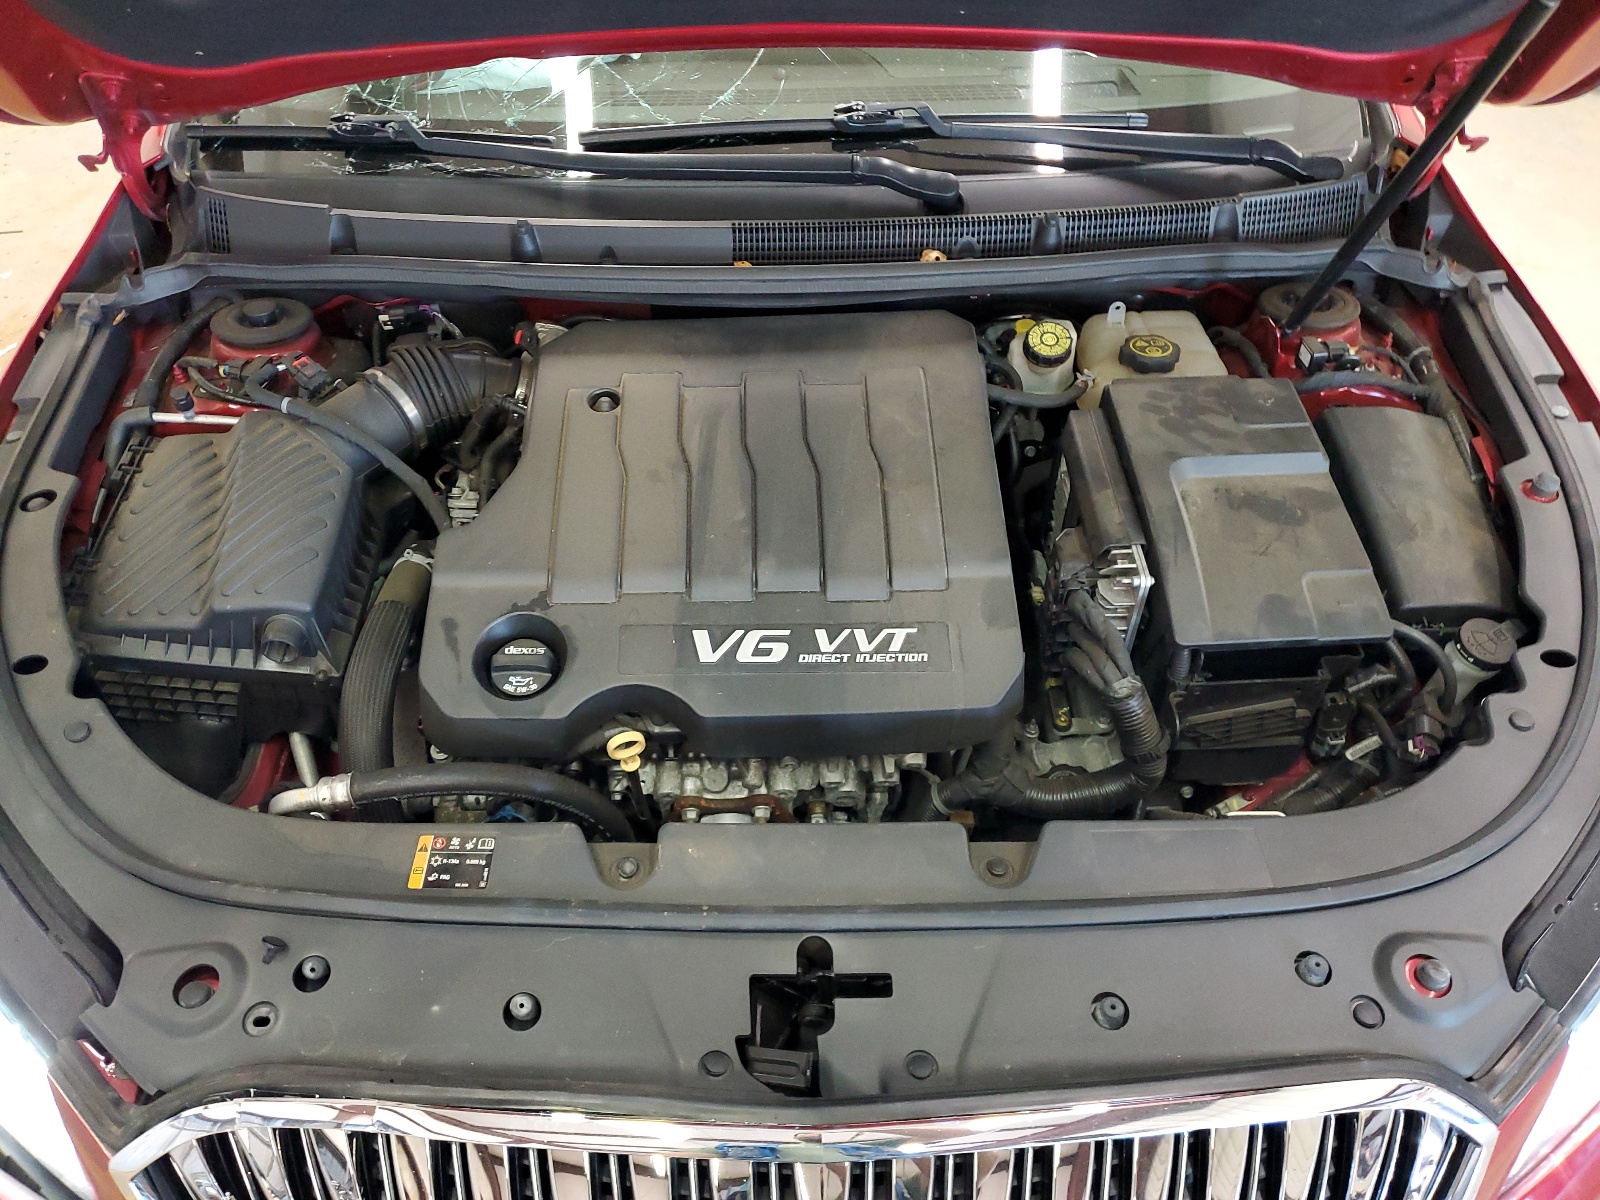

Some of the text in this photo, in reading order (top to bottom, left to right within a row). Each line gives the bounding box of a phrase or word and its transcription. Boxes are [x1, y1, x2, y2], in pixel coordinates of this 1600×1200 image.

[504, 645, 546, 655] dexos
[692, 628, 918, 663] V6 VVT
[798, 653, 928, 663] DIRECT INJECTION
[503, 683, 538, 693] SAE 5W-30
